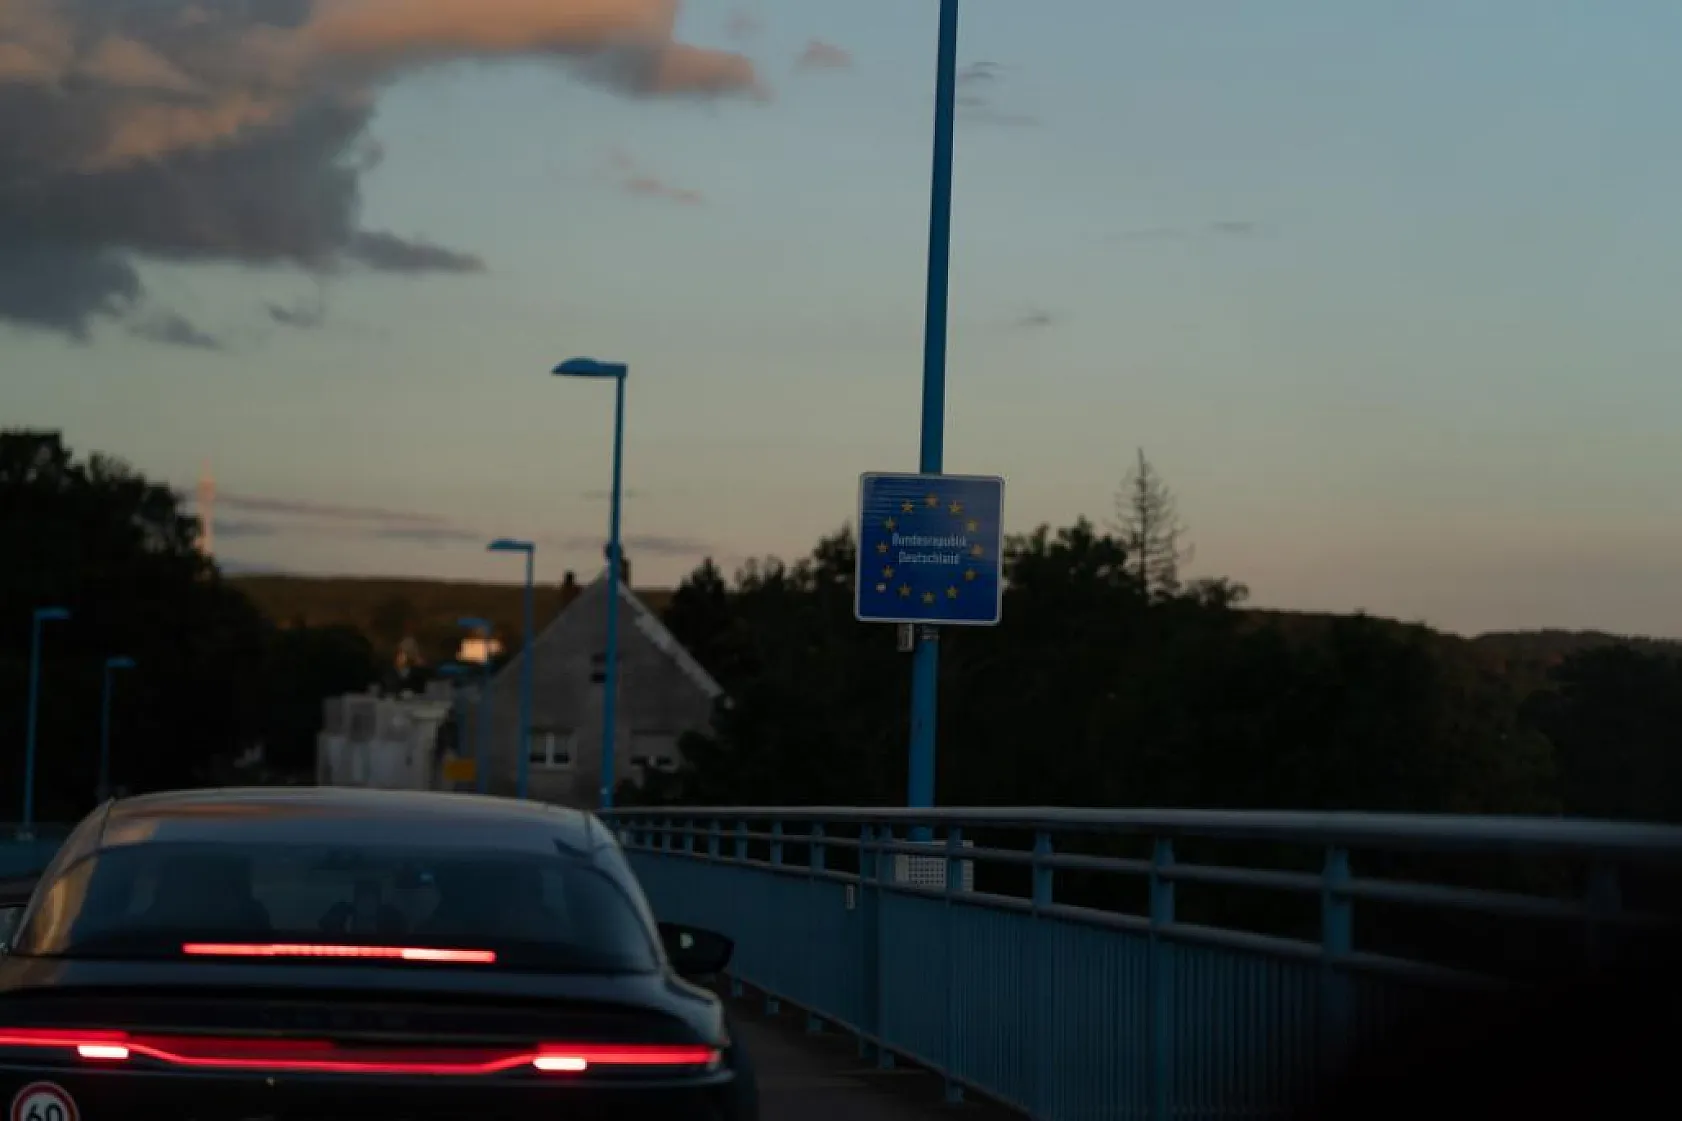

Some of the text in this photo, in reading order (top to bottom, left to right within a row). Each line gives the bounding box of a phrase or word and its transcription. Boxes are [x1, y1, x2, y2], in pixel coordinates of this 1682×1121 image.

[892, 533, 967, 549] Bundesrepublik
[898, 551, 961, 565] Deutschland
[25, 1103, 64, 1121] 60
